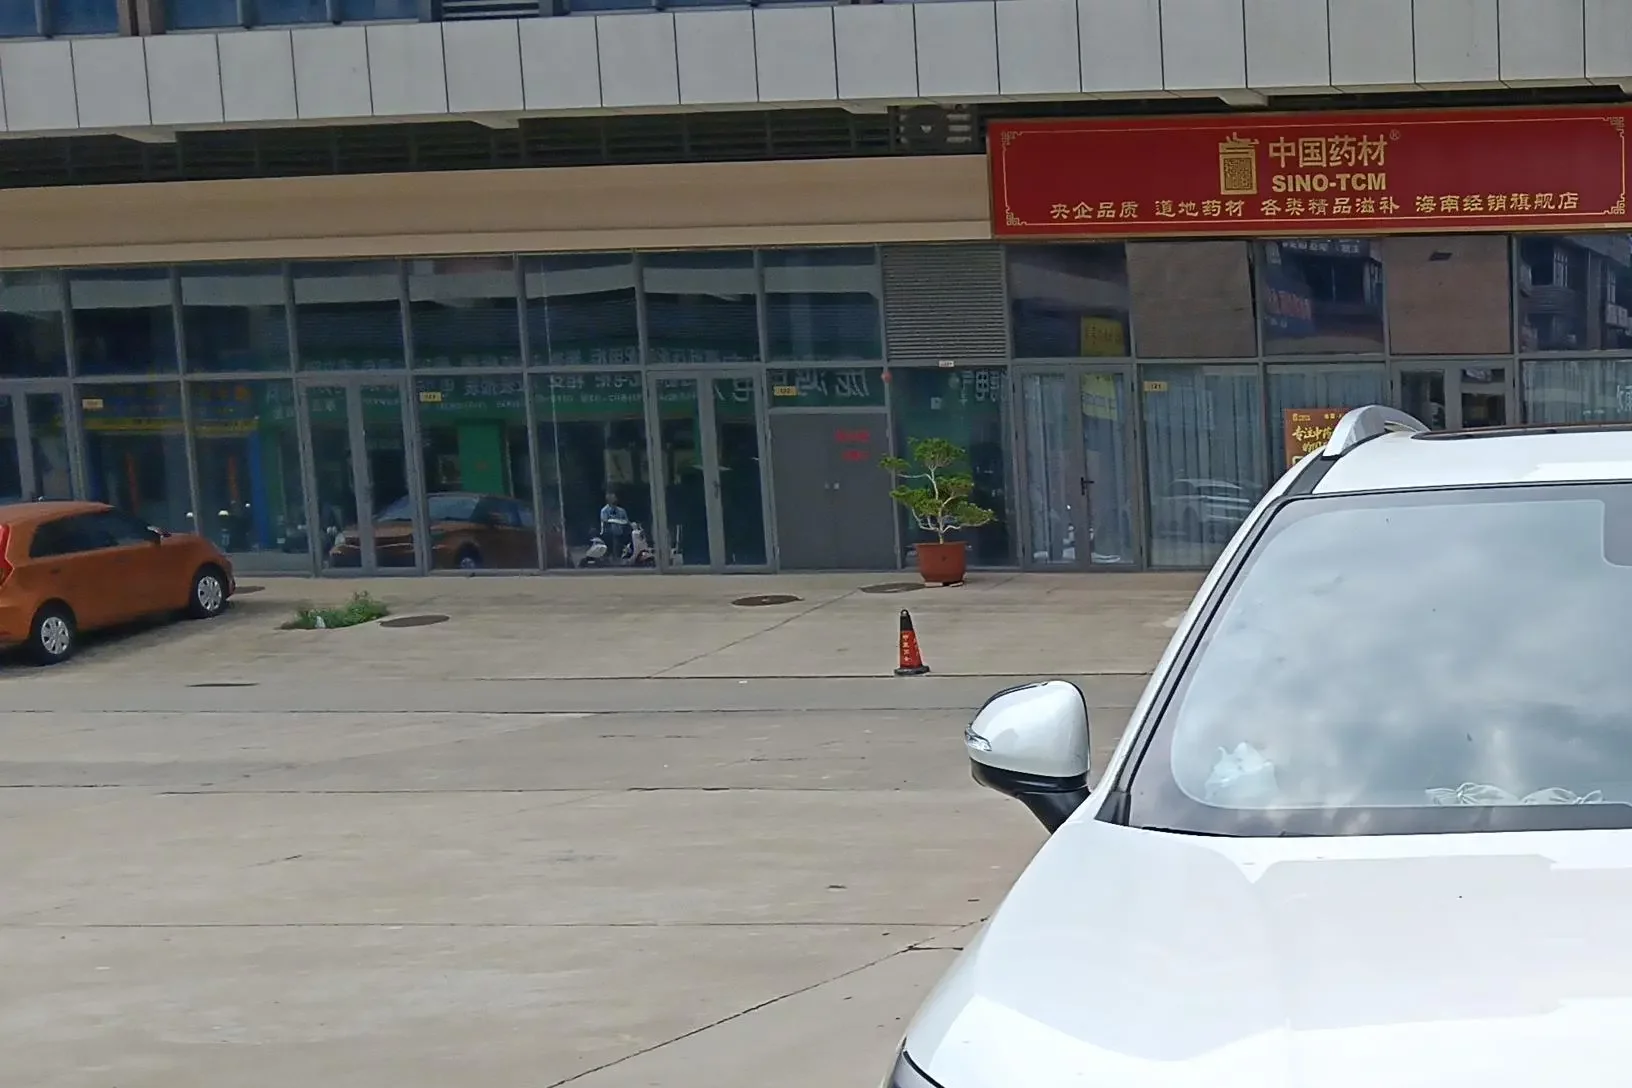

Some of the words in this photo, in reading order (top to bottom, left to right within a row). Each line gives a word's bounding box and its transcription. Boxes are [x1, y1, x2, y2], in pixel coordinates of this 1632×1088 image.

[1268, 134, 1388, 168] 中国药材
[1272, 172, 1387, 192] SINO-TCM
[1050, 201, 1139, 220] 央企品质
[1155, 199, 1245, 218] 道地药材
[1260, 196, 1400, 217] 各类精品滋补
[1415, 191, 1579, 213] 海南经销旗舰店
